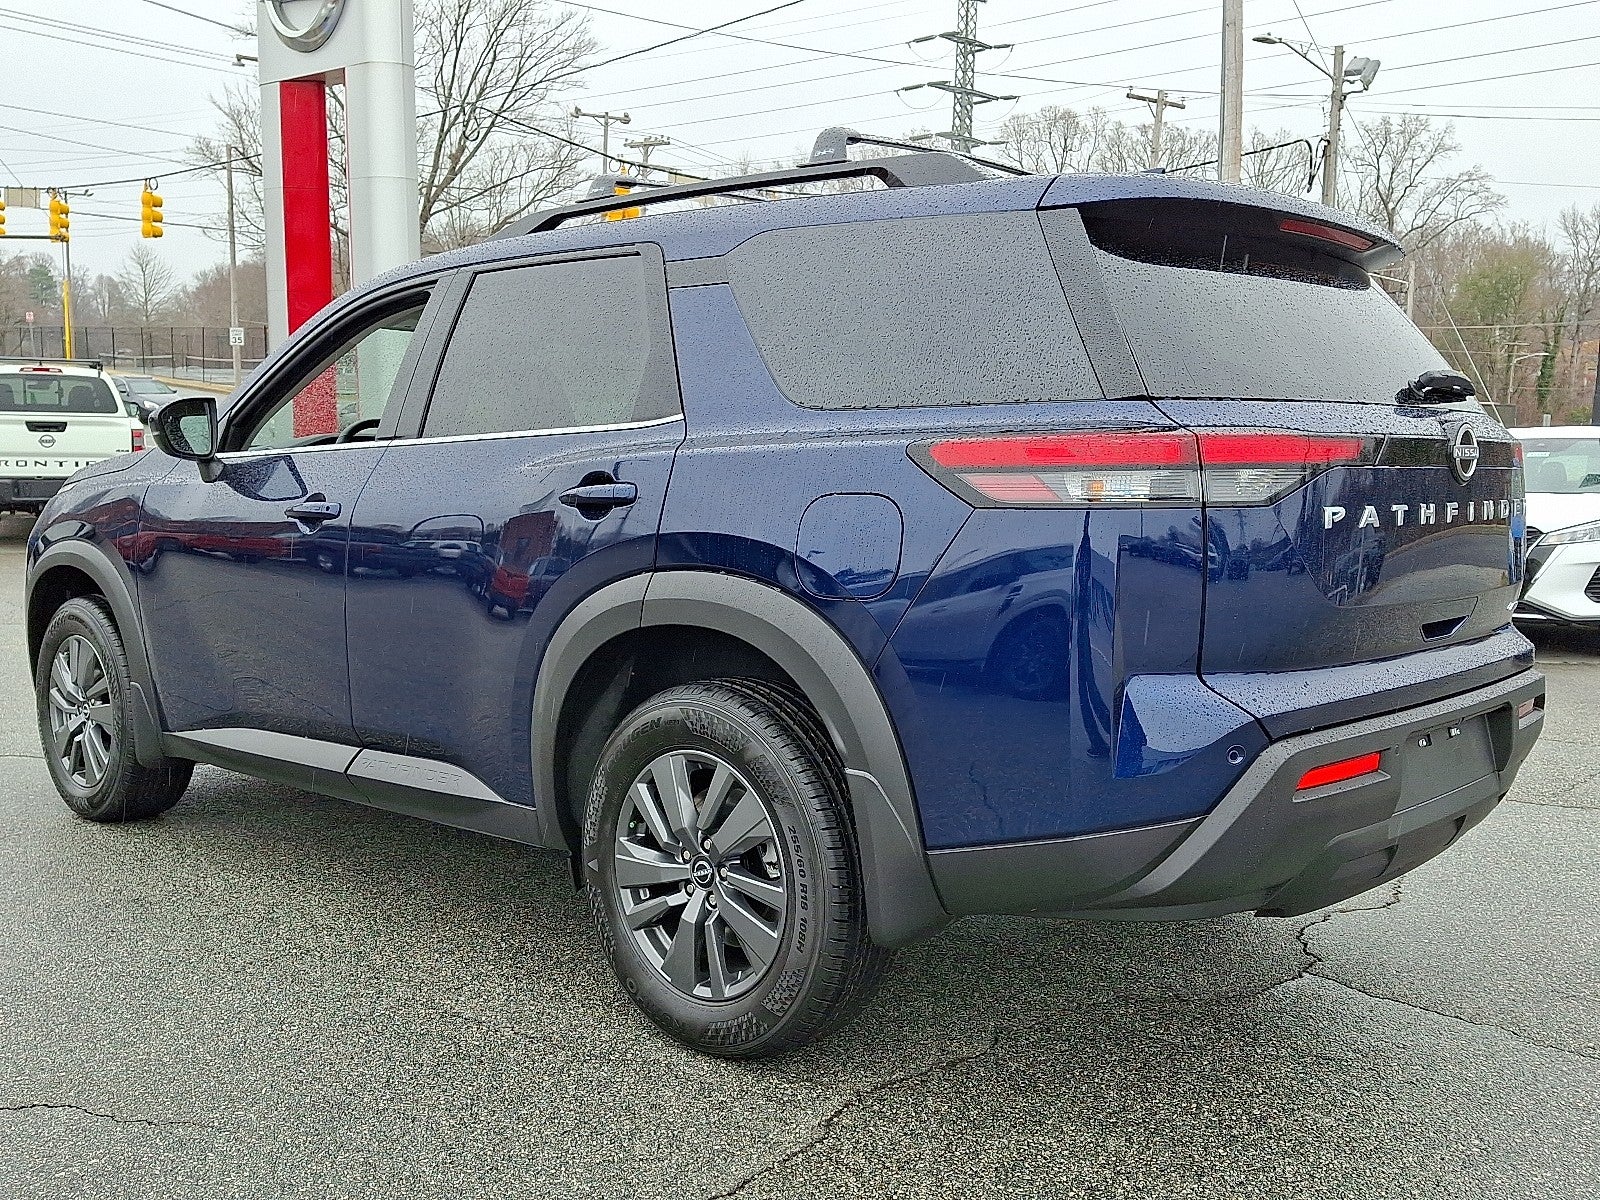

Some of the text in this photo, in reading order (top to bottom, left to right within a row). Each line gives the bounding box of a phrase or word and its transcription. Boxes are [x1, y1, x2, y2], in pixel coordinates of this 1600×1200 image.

[231, 336, 243, 344] 35
[1322, 498, 1526, 530] PATHFINDE
[787, 825, 809, 954] 255/60 R18 108H
